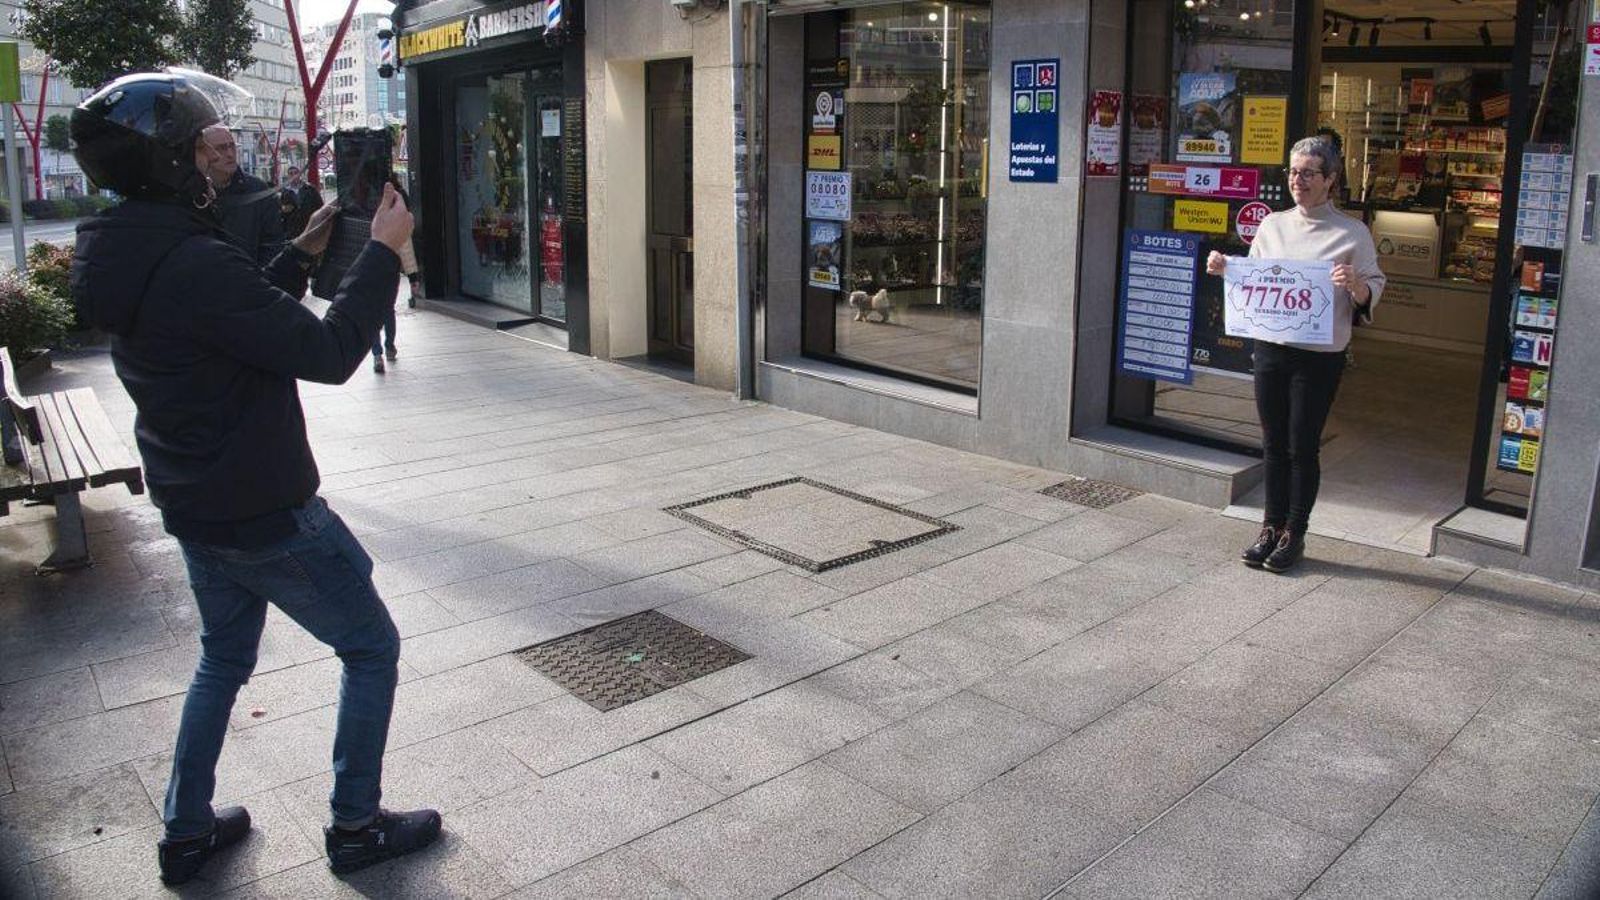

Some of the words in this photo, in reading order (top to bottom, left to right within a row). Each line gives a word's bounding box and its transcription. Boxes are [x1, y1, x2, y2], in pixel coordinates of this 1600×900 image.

[400, 20, 465, 59] BLACKWHITE
[479, 3, 549, 40] BARBERSHO
[1040, 143, 1046, 152] y
[1185, 142, 1216, 152] 89940
[813, 148, 835, 157] DHL
[1011, 155, 1043, 165] Apuestas
[1044, 155, 1056, 165] del
[1011, 168, 1035, 177] Estado
[1195, 174, 1211, 186] 26
[1180, 207, 1208, 217] Western
[1245, 207, 1266, 222] +18
[1144, 236, 1182, 249] BOTES
[1263, 276, 1296, 285] PREMIO
[1242, 285, 1313, 311] 77768
